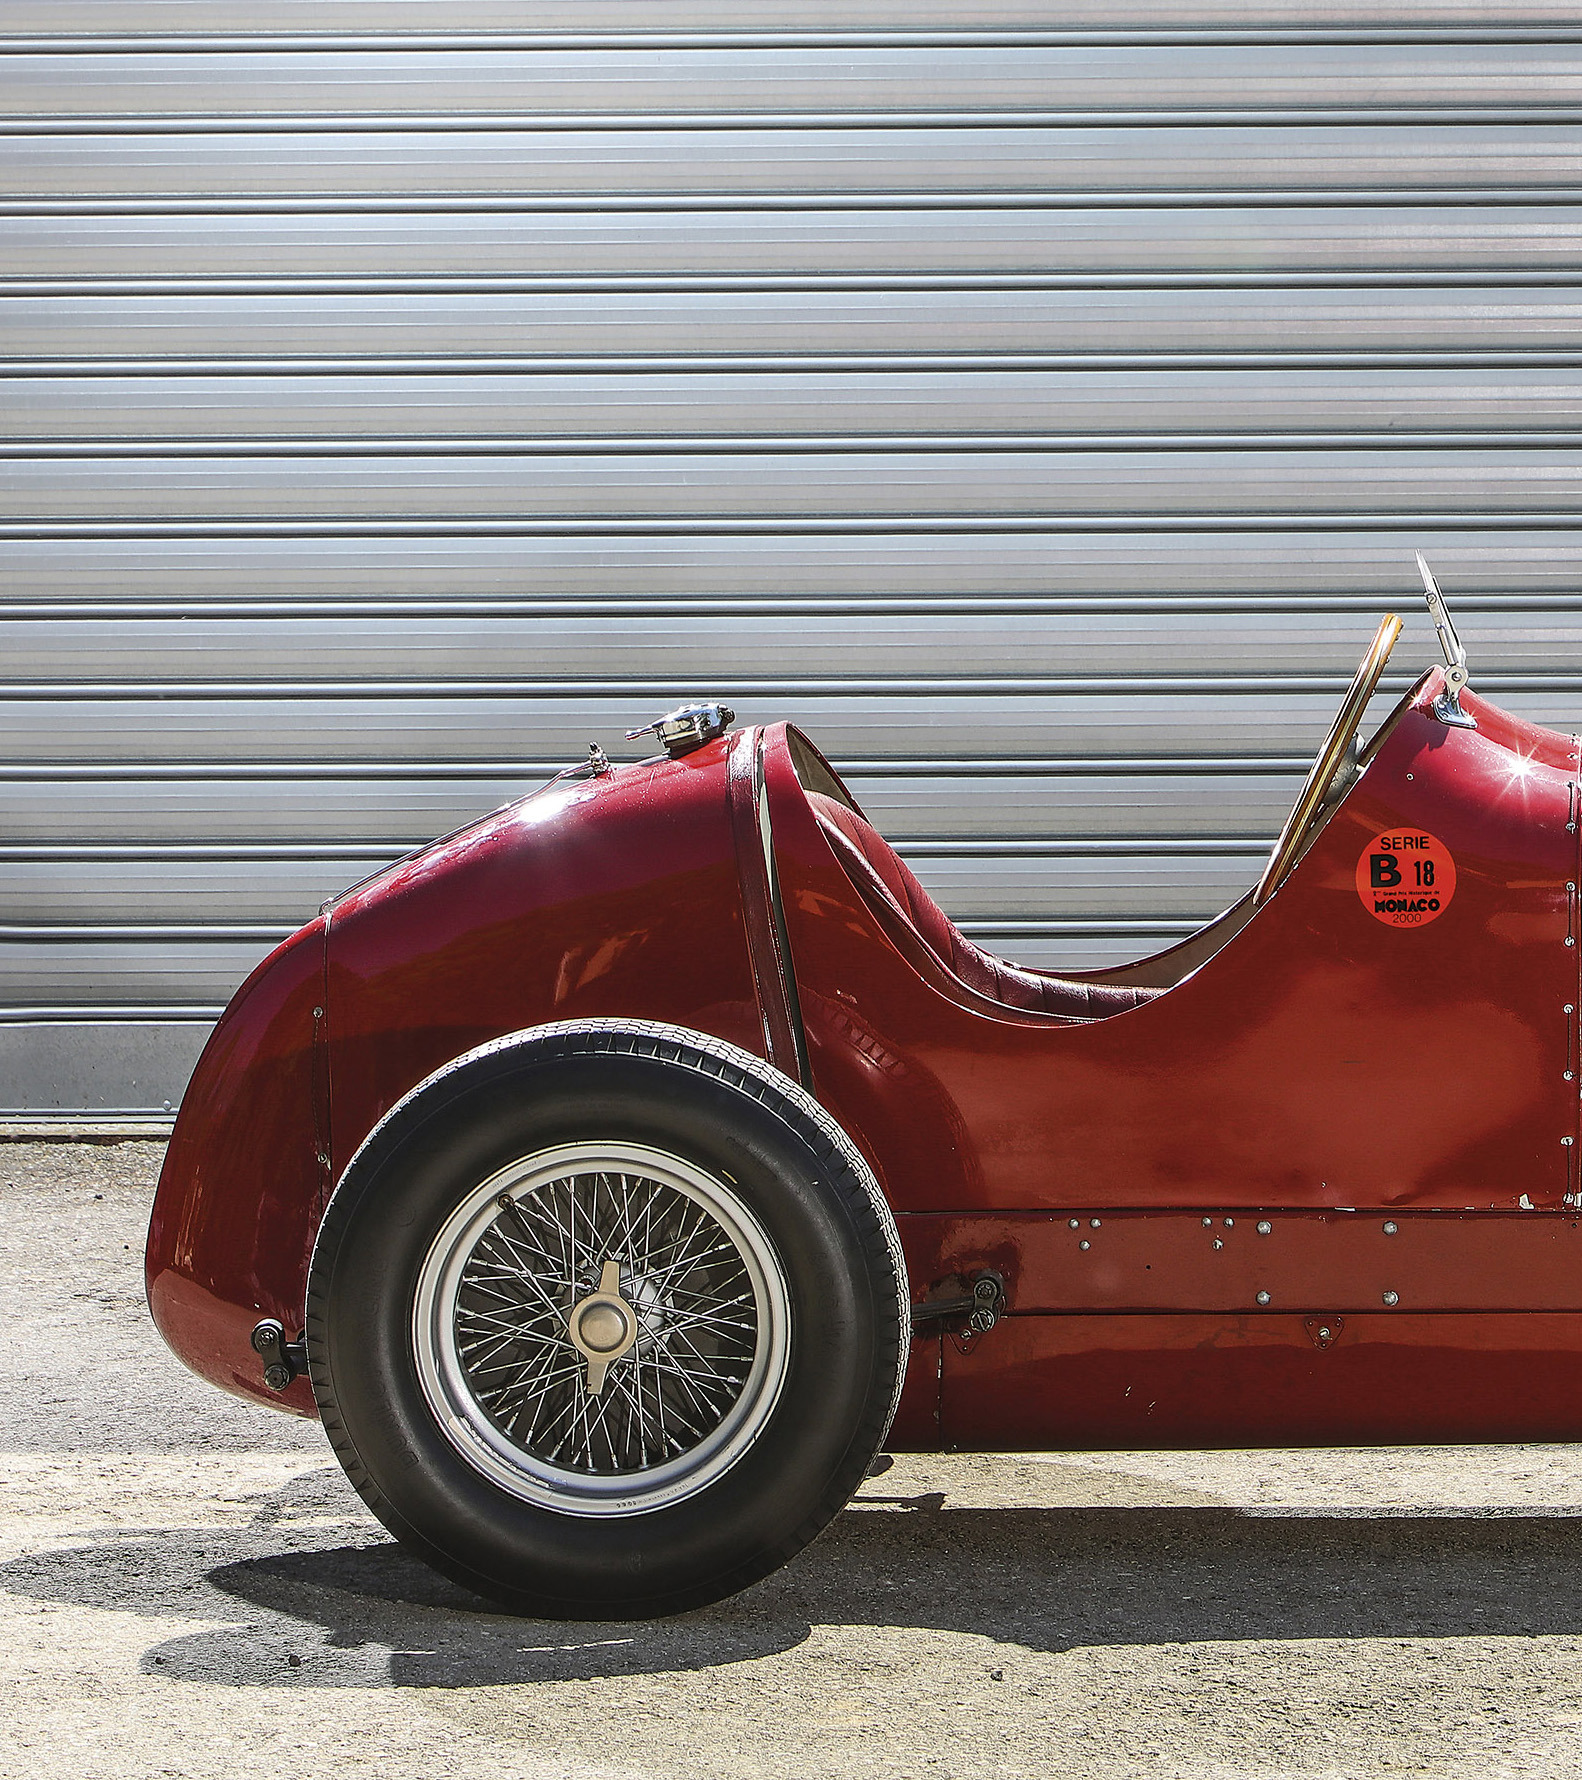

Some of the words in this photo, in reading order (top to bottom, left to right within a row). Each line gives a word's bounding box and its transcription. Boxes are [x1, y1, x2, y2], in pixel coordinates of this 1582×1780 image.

[1380, 836, 1430, 850] SERIE
[1370, 854, 1402, 888] B
[1414, 860, 1434, 886] 18
[1374, 898, 1440, 913] MONACO
[1392, 913, 1422, 924] 2000
